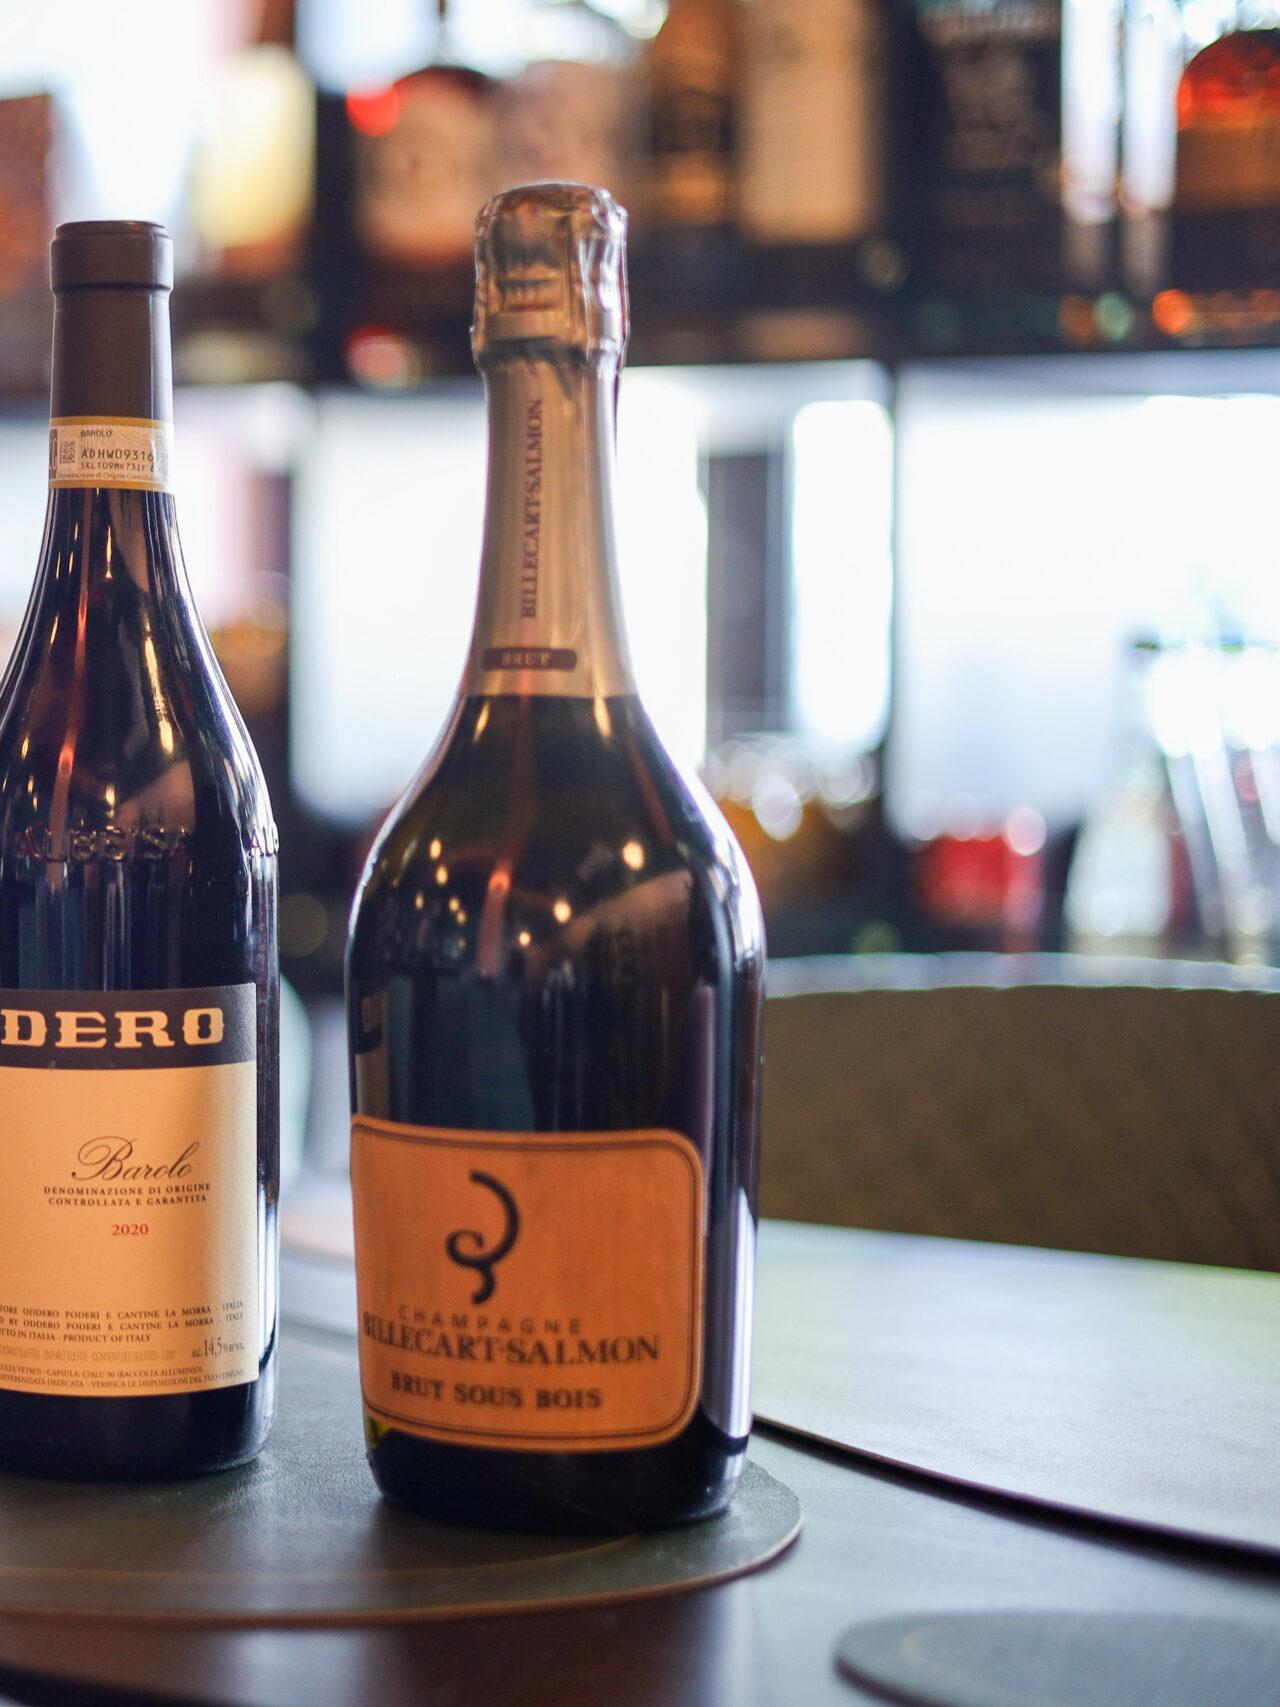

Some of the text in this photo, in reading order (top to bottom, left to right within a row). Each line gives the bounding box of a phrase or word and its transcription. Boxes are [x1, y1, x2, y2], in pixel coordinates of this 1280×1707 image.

[81, 430, 113, 438] BAROLO
[71, 1136, 200, 1181] Barolo
[44, 1182, 211, 1196] DENOMINAZIONE DI ORIGINE
[48, 1194, 207, 1207] CONTROLLATA E GARANTITA
[111, 1223, 149, 1236] 2020
[22, 1308, 60, 1317] ODDERO
[65, 1310, 100, 1319] PODERI
[117, 1310, 161, 1319] CANTINE
[165, 1309, 176, 1317] LA
[182, 1306, 211, 1316] MORRA
[222, 1301, 244, 1311] ITALIA
[9, 1317, 18, 1326] BY
[23, 1320, 60, 1329] ODDERO
[66, 1322, 100, 1331] PODERI
[119, 1322, 161, 1330] CANTINE
[168, 1321, 179, 1329] LA
[185, 1317, 214, 1327] MORRA
[226, 1312, 244, 1322] ITALY
[398, 1304, 583, 1335] CHAMPAGNE
[17, 1330, 27, 1339] IN
[29, 1332, 55, 1341] ITALIA
[63, 1334, 107, 1343] PRODUCT
[110, 1335, 122, 1343] OF
[126, 1334, 152, 1343] ITALY
[390, 1370, 603, 1410] BRUT SOUS BOIS
